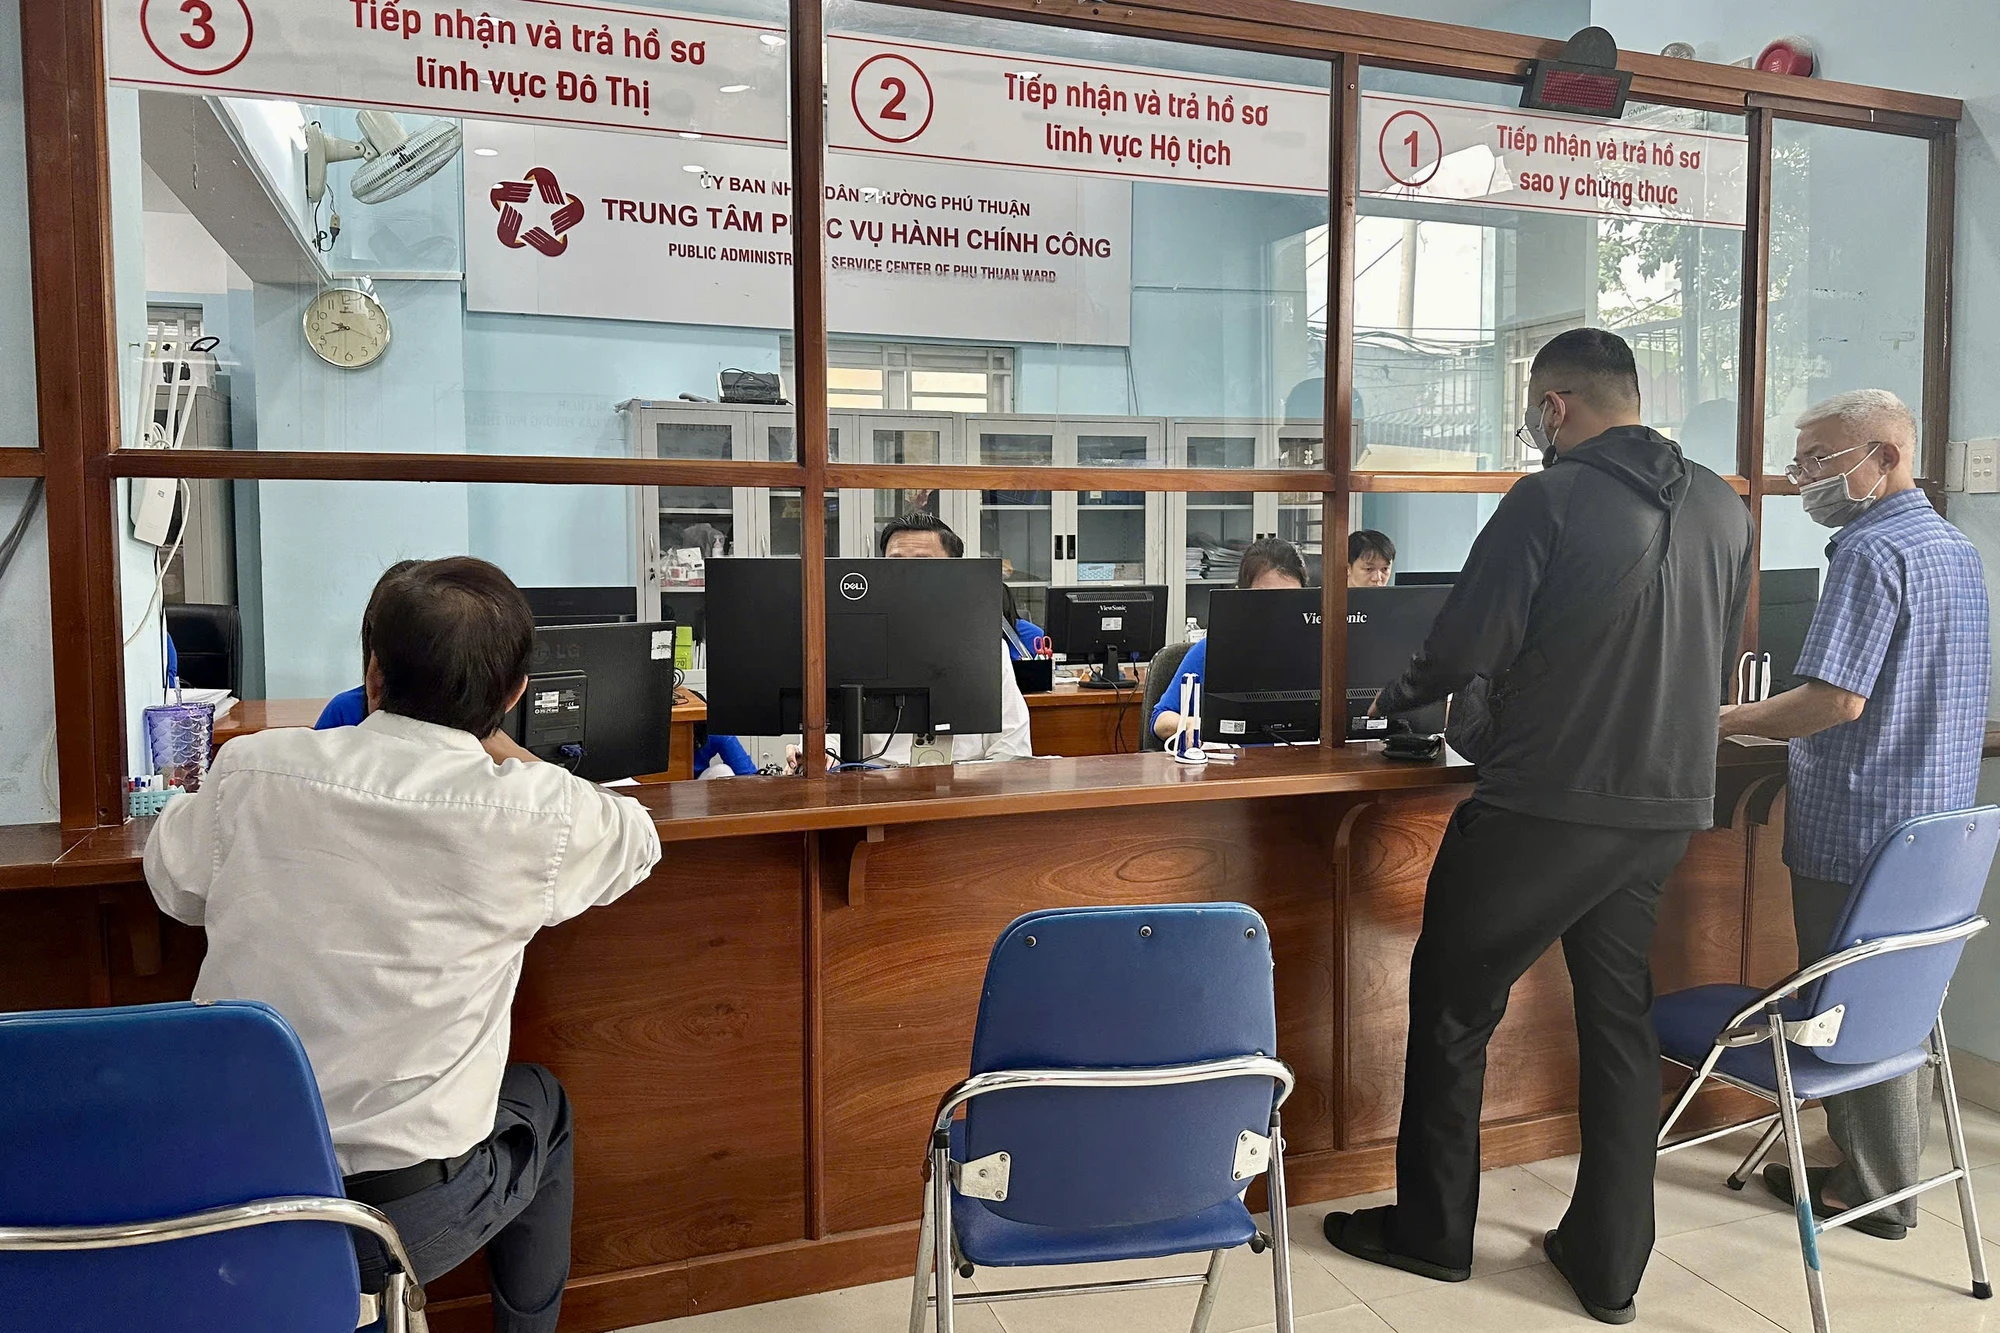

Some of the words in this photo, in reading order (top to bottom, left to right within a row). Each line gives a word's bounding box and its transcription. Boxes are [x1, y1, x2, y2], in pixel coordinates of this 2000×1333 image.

[180, 0, 216, 50] 3
[351, 0, 422, 40] Tiếp
[434, 9, 516, 49] nhận
[526, 20, 562, 50] và
[572, 24, 614, 56] trả
[625, 28, 661, 61] hồ
[671, 40, 706, 66] sơ
[416, 56, 480, 92] lĩnh
[488, 70, 546, 104] vực
[556, 71, 598, 104] Đô
[605, 76, 650, 116] Thị
[880, 76, 907, 122] 2
[1004, 72, 1058, 110] Tiếp
[1066, 81, 1127, 117] nhận
[1134, 89, 1161, 116] và
[1168, 93, 1199, 119] trả
[1207, 95, 1235, 124] hồ
[1241, 104, 1269, 127] sơ
[1046, 122, 1092, 154] lĩnh
[1099, 133, 1143, 163] vực
[1151, 133, 1181, 168] Hộ
[1188, 138, 1231, 170] tịch
[1403, 130, 1418, 168] 1
[1496, 125, 1538, 157] Tiếp
[1544, 132, 1591, 162] nhận
[1596, 138, 1617, 161] và
[1623, 140, 1647, 165] trả
[1652, 142, 1674, 167] hồ
[1679, 150, 1701, 170] sơ
[699, 170, 725, 190] ỦY
[729, 177, 766, 194] BAN
[824, 183, 859, 203] DÂN
[941, 194, 973, 212] PHÚ
[977, 199, 1031, 219] THUẬN
[1520, 171, 1554, 193] sao
[1559, 175, 1570, 200] y
[1575, 173, 1633, 207] chứng
[1638, 179, 1678, 209] thực
[601, 197, 699, 228] TRUNG
[706, 203, 763, 233] TÂM
[849, 219, 884, 248] VỤ
[891, 219, 959, 249] HÀNH
[966, 226, 1038, 254] CHÍNH
[1045, 231, 1111, 259] CÔNG
[668, 243, 717, 261] PUBLIC
[831, 255, 883, 272] SERVICE
[886, 260, 931, 275] CENTER
[935, 263, 950, 276] OF
[953, 264, 977, 279] PHU
[980, 266, 1019, 281] THUAN
[1022, 269, 1056, 284] WARD
[316, 310, 328, 321] 10
[327, 299, 335, 310] 11
[368, 310, 376, 321] 2
[311, 322, 320, 333] 9
[376, 324, 384, 335] 3
[331, 346, 338, 357] 7
[344, 351, 354, 362] 6
[360, 346, 369, 358] 5
[843, 582, 866, 590] DELL
